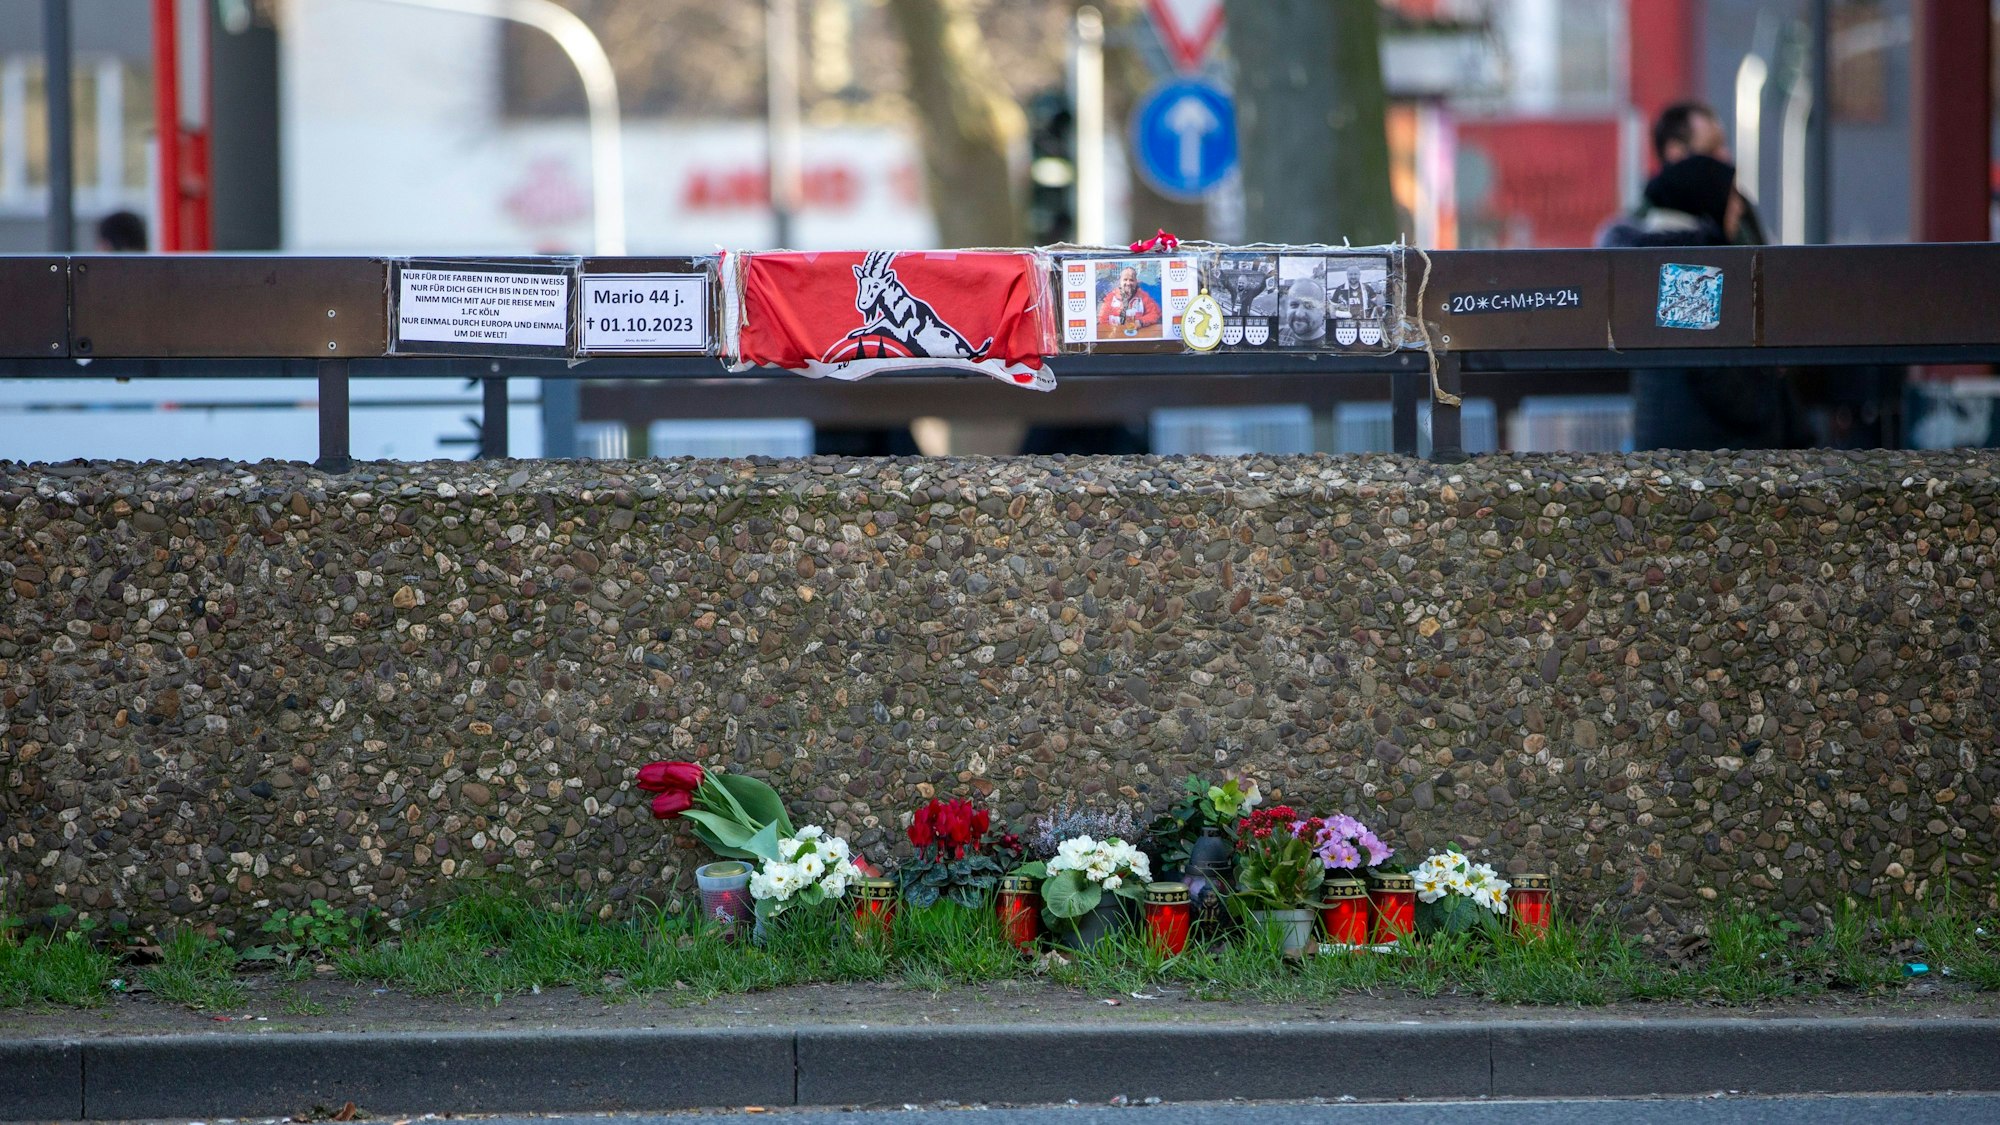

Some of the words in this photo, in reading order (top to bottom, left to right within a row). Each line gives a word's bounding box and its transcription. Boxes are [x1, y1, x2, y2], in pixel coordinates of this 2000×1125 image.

[402, 272, 421, 280] NUR
[421, 272, 437, 281] FÜR
[438, 273, 451, 281] DIE
[452, 274, 483, 282] FARBEN
[484, 275, 493, 283] IN
[494, 276, 510, 284] ROT
[511, 276, 529, 285] UND
[530, 277, 539, 285] IN
[540, 277, 565, 286] WEISS
[410, 284, 428, 292] NUR
[430, 283, 445, 292] FÜR
[446, 285, 465, 293] DICH
[466, 286, 483, 294] GEH
[499, 287, 511, 295] BIS
[512, 287, 521, 295] IN
[522, 288, 540, 296] DEN
[540, 288, 560, 297] TOD!
[415, 295, 440, 303] NIMM
[441, 296, 462, 304] MICH
[464, 297, 479, 305] MIT
[480, 297, 496, 305] AUF
[497, 298, 510, 306] DIE
[512, 298, 533, 306] REISE
[534, 299, 555, 307] MEIN
[594, 289, 645, 304] Mario
[648, 290, 670, 304] 44
[673, 289, 684, 307] j.
[461, 308, 478, 316] 1.FC
[479, 307, 500, 317] KÖLN
[401, 317, 419, 325] NUR
[420, 317, 451, 326] EINMAL
[452, 319, 480, 327] DURCH
[481, 320, 513, 328] EUROPA
[514, 321, 532, 329] UND
[533, 321, 564, 330] EINMAL
[600, 317, 693, 332] 01.10.2023
[469, 330, 483, 338] DIE
[484, 330, 508, 339] WELT!
